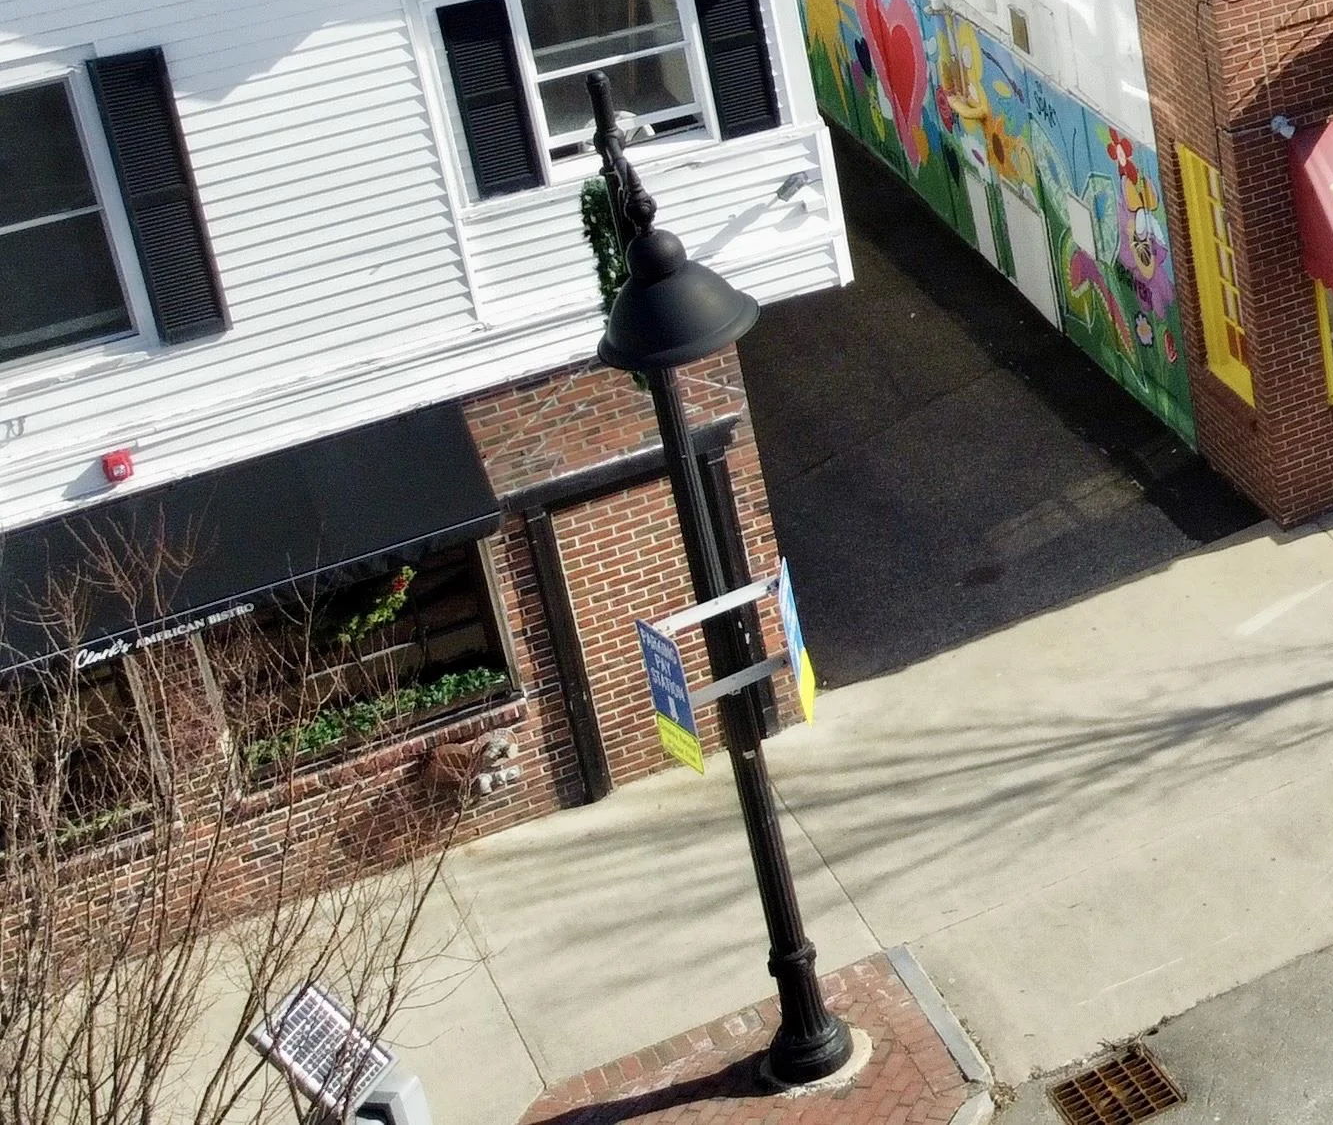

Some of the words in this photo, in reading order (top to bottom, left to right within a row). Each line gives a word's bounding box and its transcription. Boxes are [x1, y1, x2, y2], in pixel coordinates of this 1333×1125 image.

[135, 618, 205, 649] AMERICAN
[207, 602, 255, 625] BISTRO
[640, 628, 678, 664] PARKING
[654, 653, 671, 677] PAY
[651, 667, 686, 704] STATION
